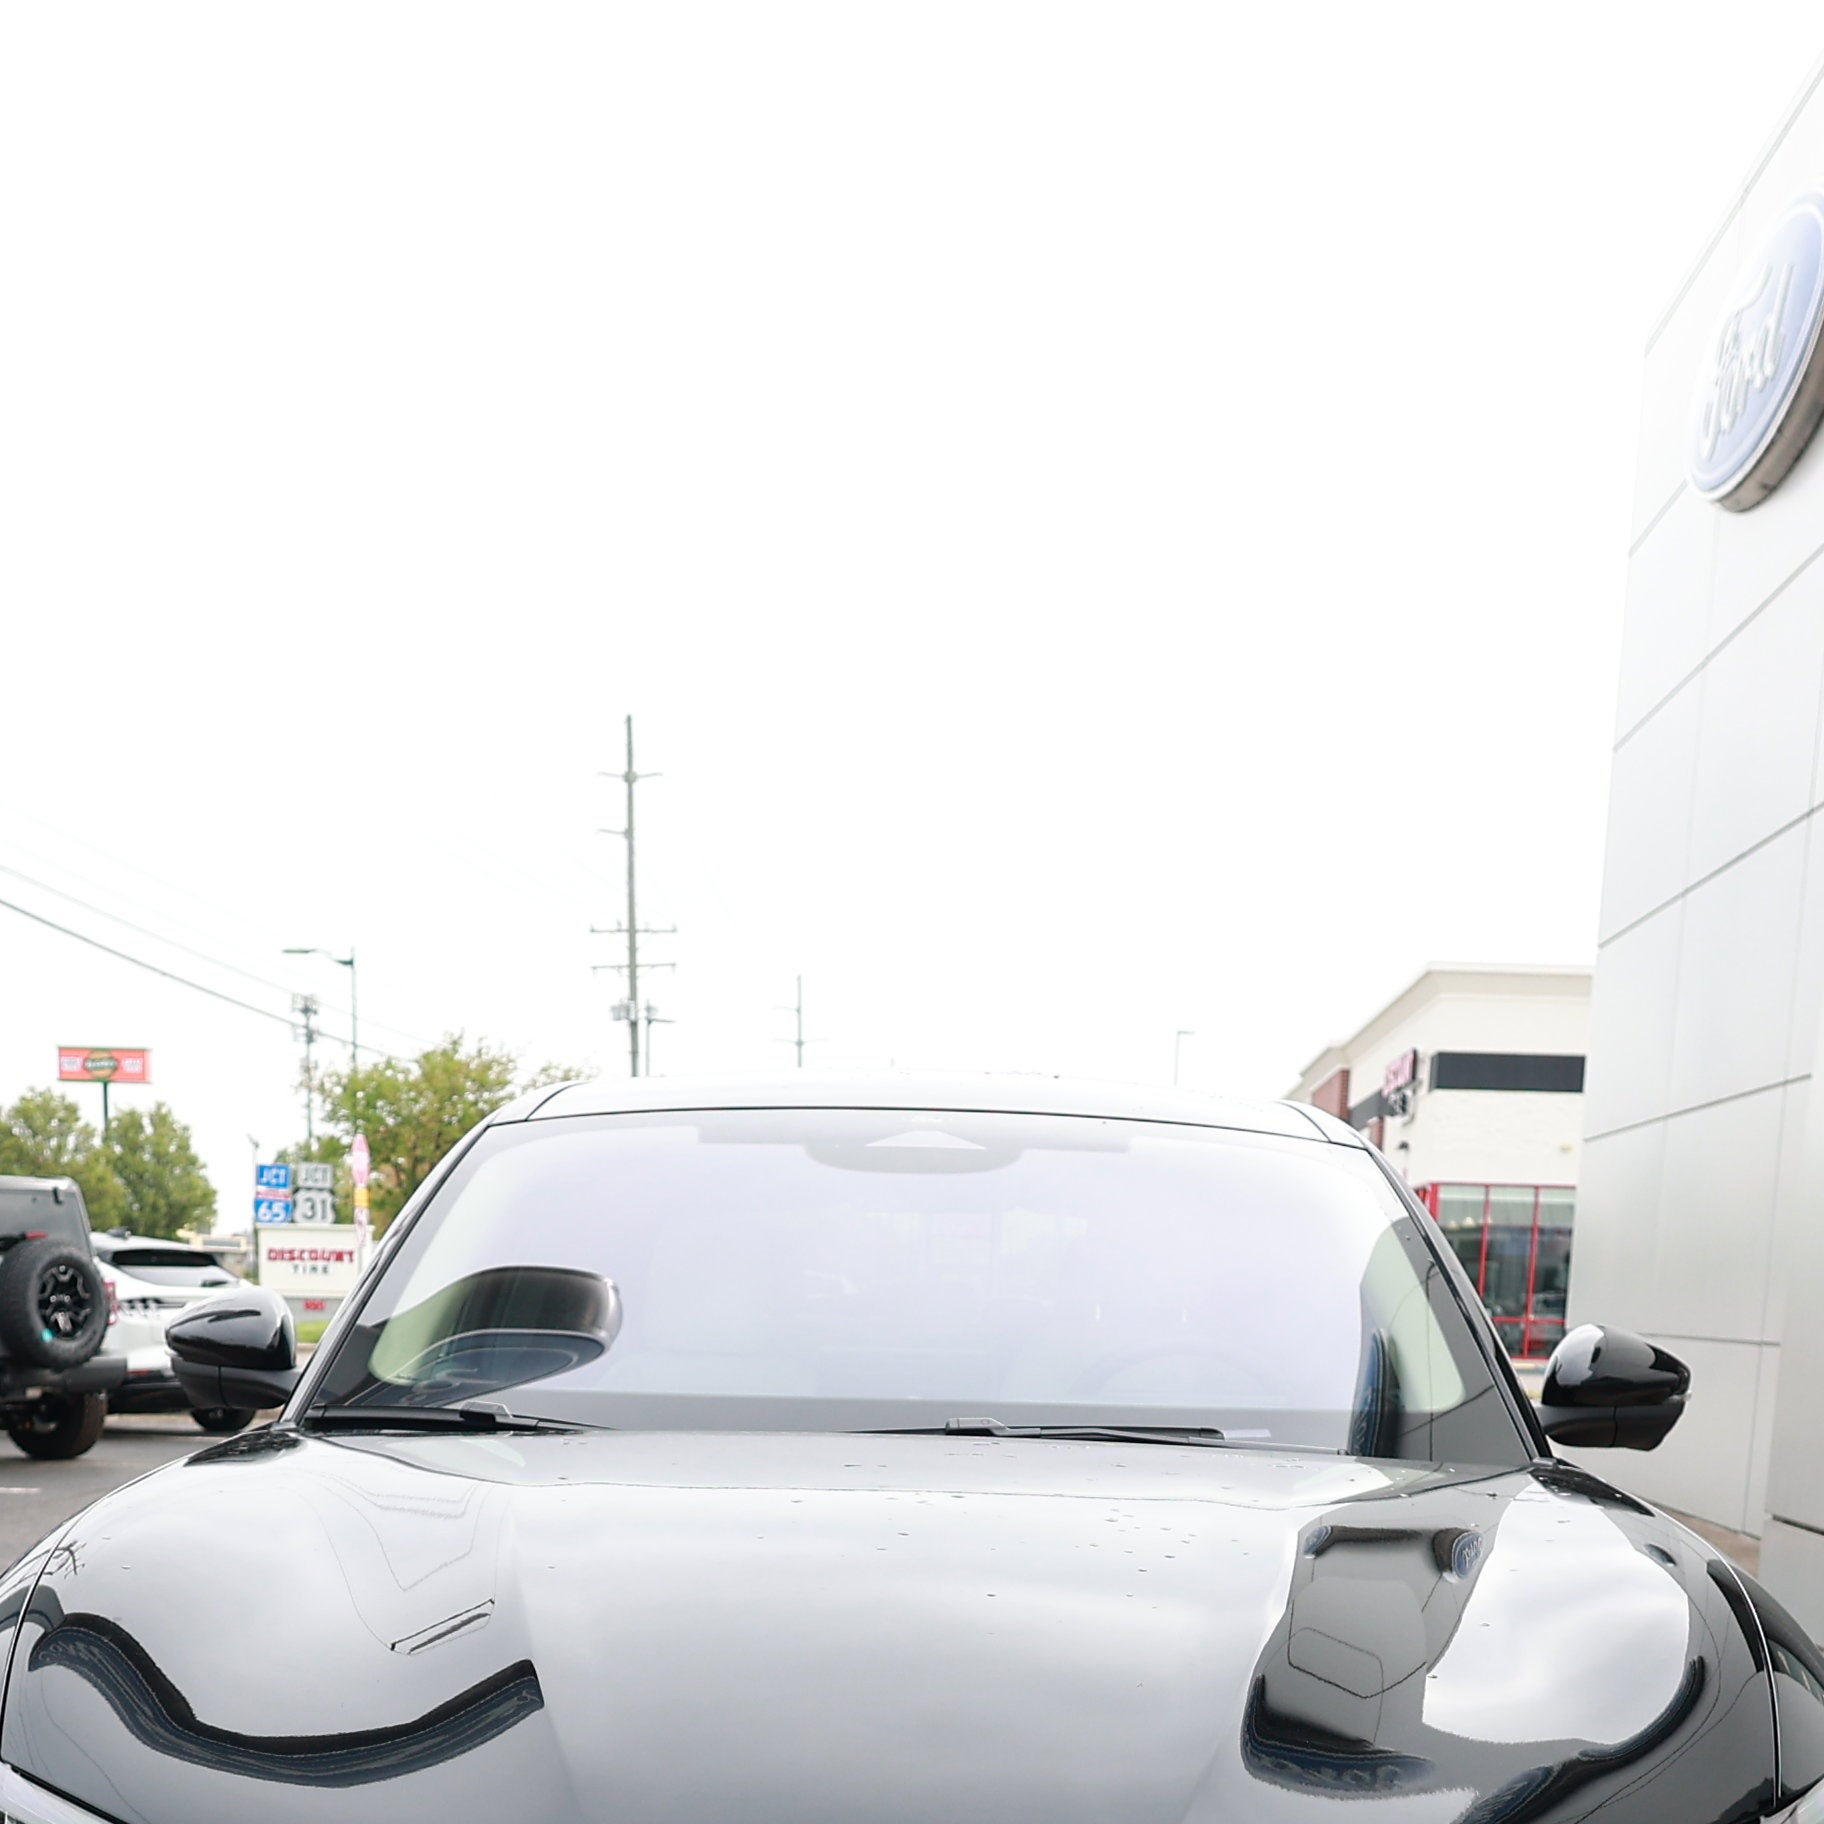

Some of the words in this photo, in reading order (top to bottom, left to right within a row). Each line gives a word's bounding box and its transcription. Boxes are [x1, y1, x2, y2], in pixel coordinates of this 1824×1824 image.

[258, 1200, 287, 1222] 65
[302, 1197, 327, 1220] 31
[268, 1248, 353, 1262] DISCOUNT
[292, 1264, 328, 1273] TIRE
